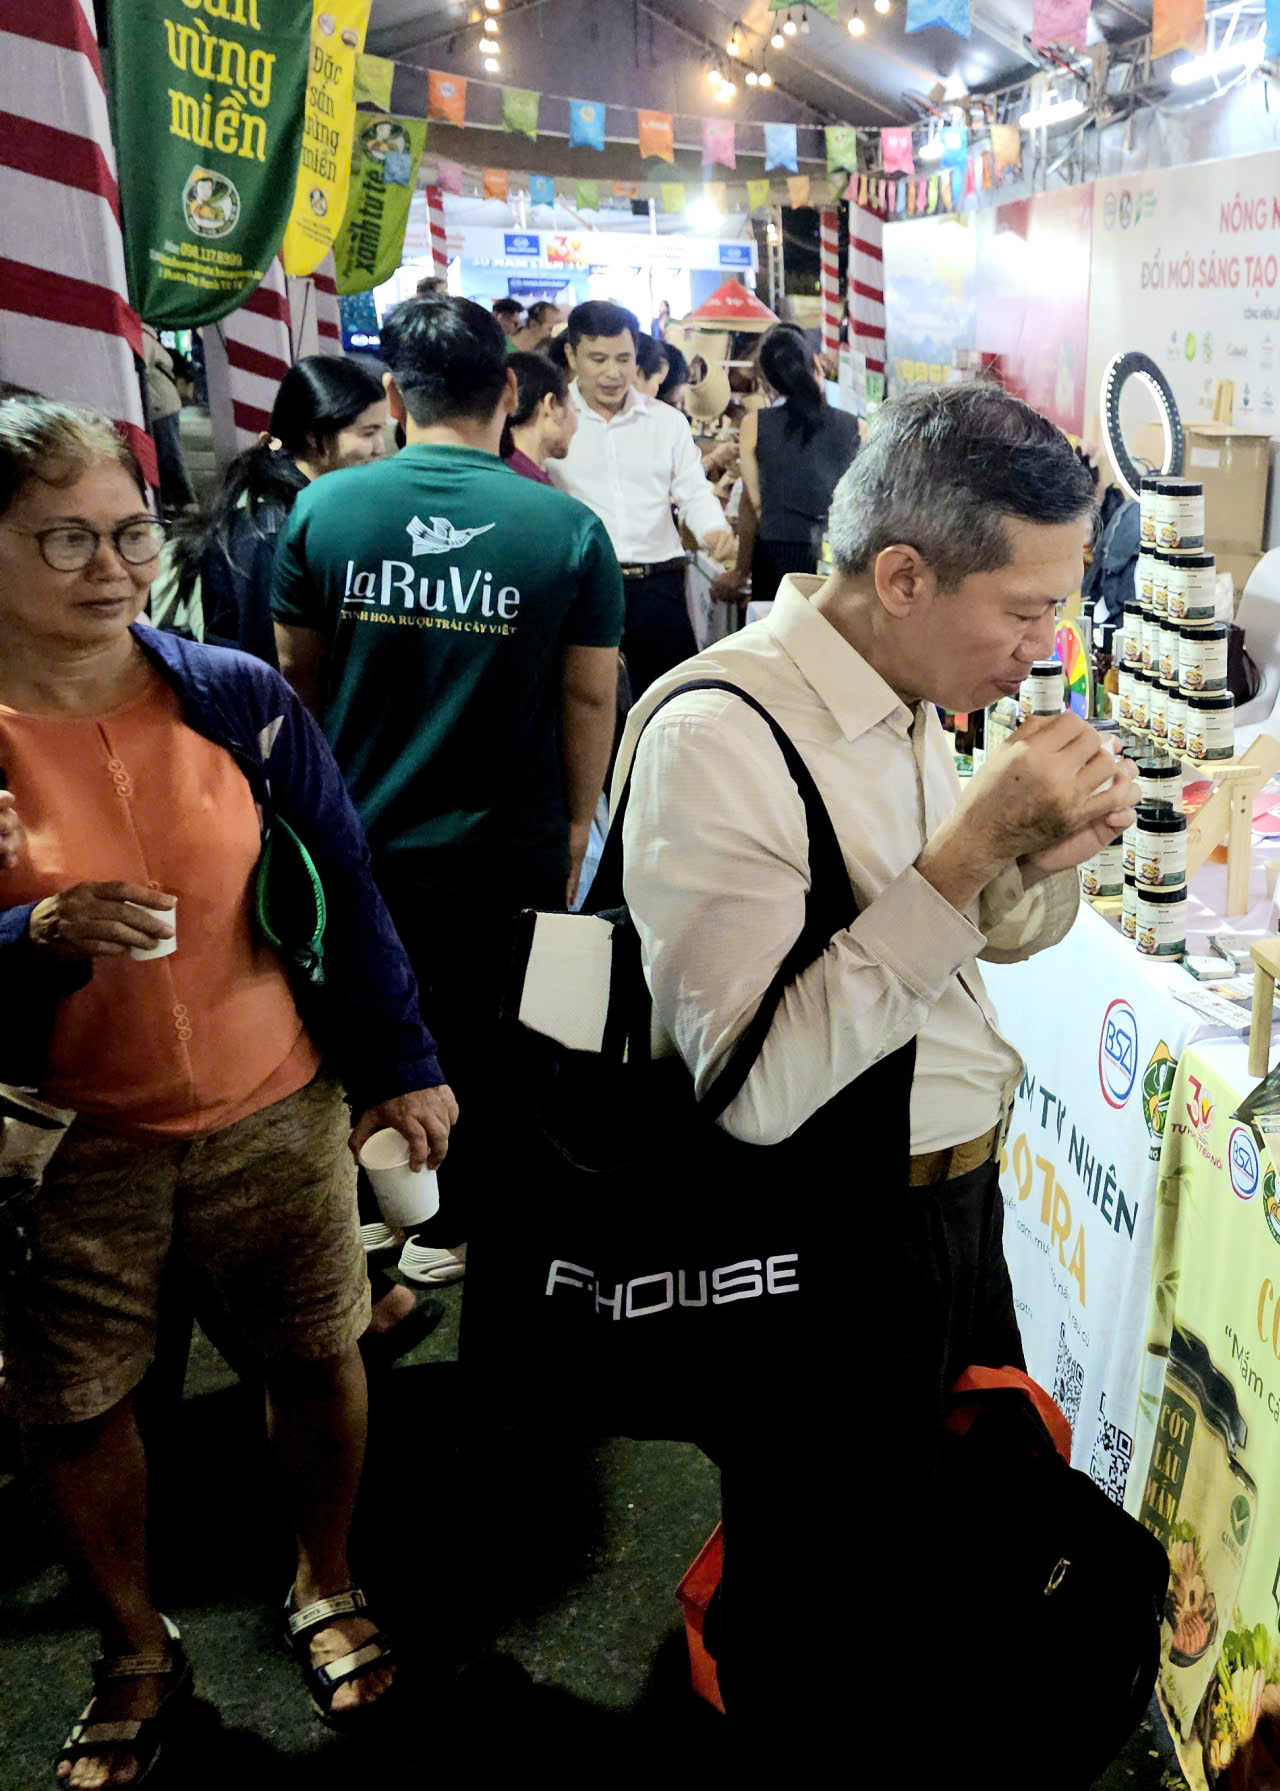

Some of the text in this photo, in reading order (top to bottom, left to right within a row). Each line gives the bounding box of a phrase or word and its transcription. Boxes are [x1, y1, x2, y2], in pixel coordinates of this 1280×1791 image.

[168, 88, 267, 162] miền
[1219, 191, 1267, 234] NÔNG
[1198, 249, 1241, 288] SÁNG
[1244, 252, 1279, 299] TẠO
[344, 559, 521, 620] laRuVie
[370, 612, 396, 624] HOA
[1104, 1019, 1133, 1079] BSA
[1068, 1122, 1139, 1241] NHIÊN
